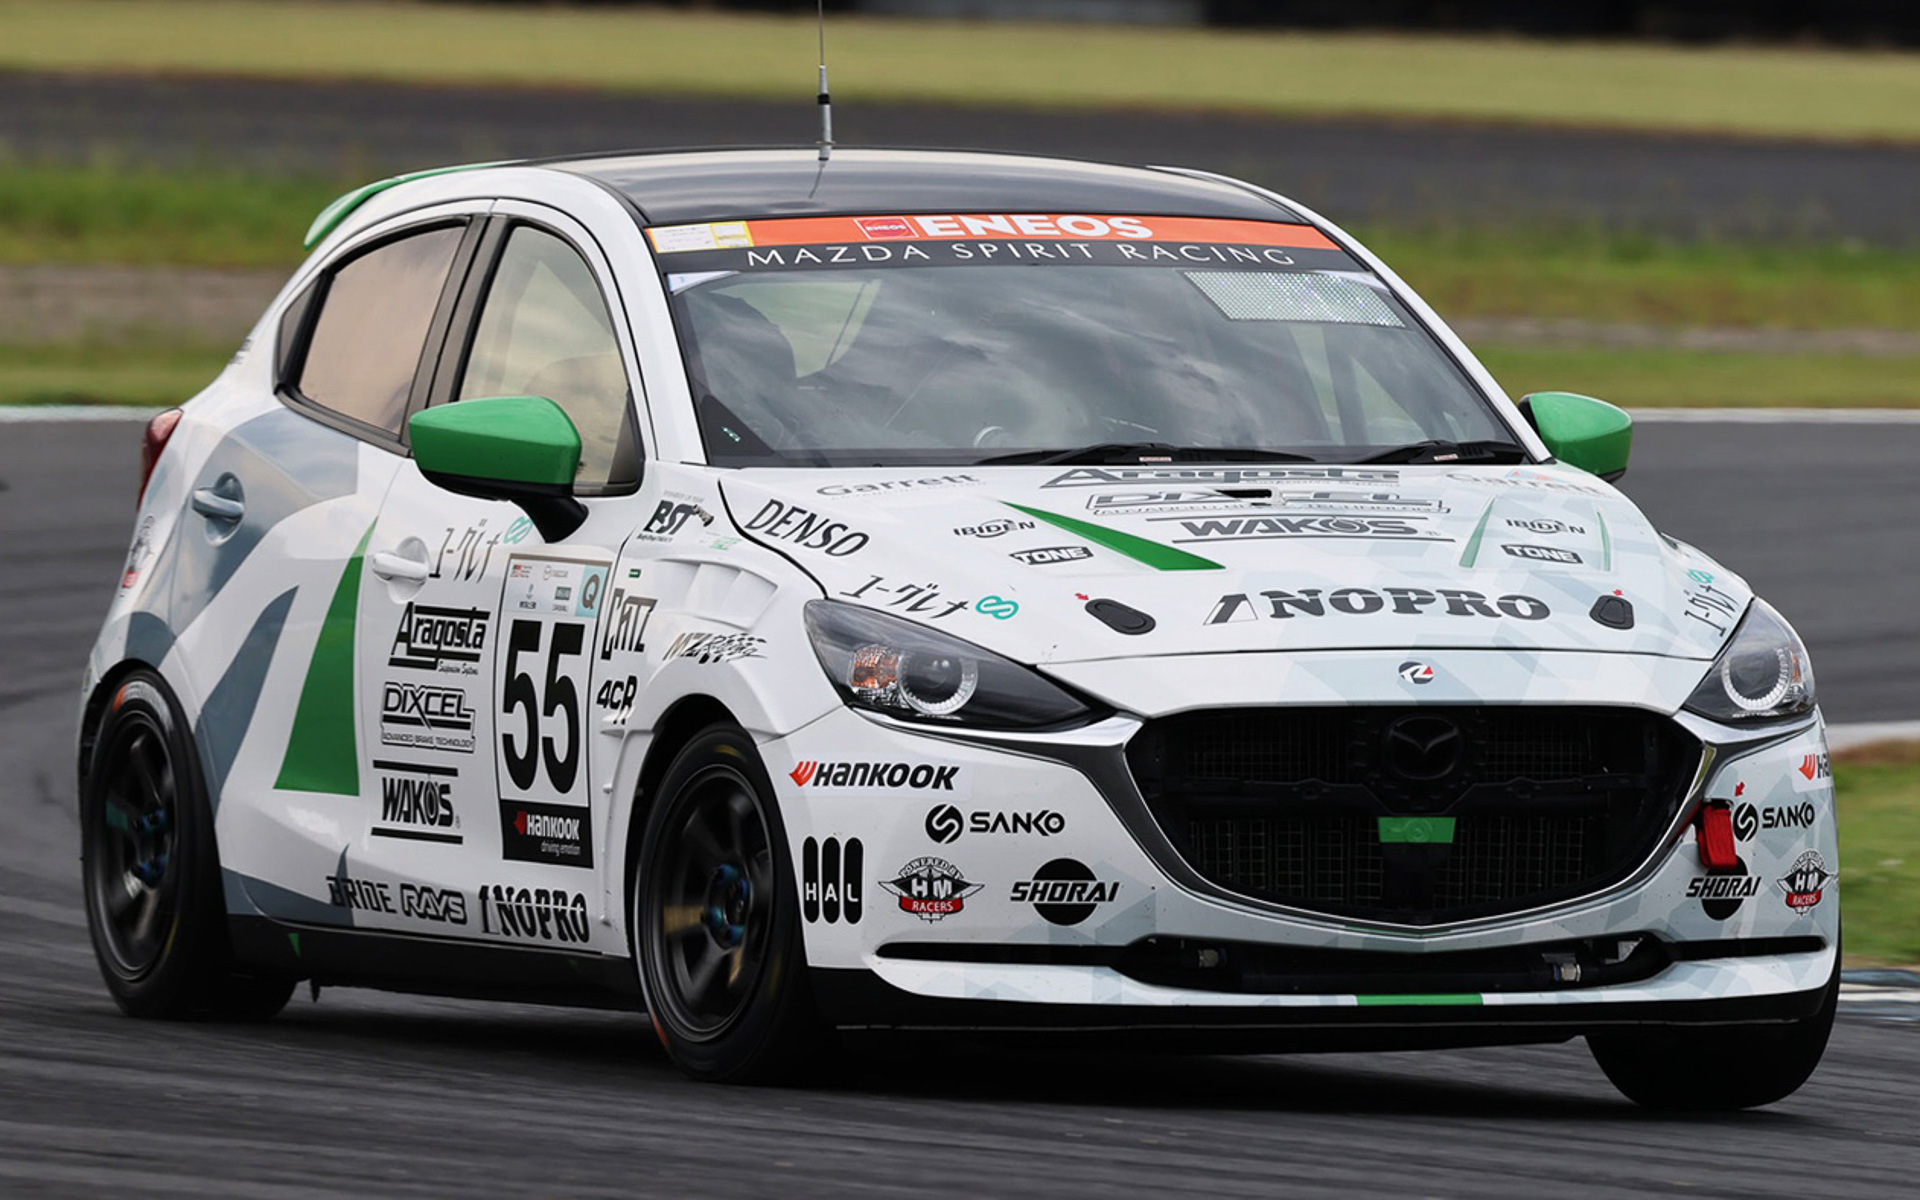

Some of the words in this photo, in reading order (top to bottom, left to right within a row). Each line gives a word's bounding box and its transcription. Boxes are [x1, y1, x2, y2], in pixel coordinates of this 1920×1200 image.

[913, 215, 1153, 239] ENEOS
[747, 245, 930, 267] MAZDA
[951, 243, 1093, 259] SPIRIT
[1117, 244, 1295, 266] RACING
[816, 474, 980, 496] Garrett
[1040, 467, 1400, 490] Aragosta
[744, 499, 870, 557] DENSO
[953, 519, 1036, 538] IBIDEN
[1505, 519, 1586, 534] IBIDEN
[1013, 548, 1089, 564] TONE
[1507, 547, 1575, 563] TONE
[582, 573, 600, 610] Q
[1259, 588, 1551, 620] NOPRO
[390, 602, 491, 664] Aragosta
[383, 688, 472, 731] DIXCEL
[502, 619, 585, 794] 55
[970, 810, 1065, 836] SANKO
[1762, 802, 1815, 829] SANKO
[326, 876, 397, 914] BRIDE
[911, 879, 953, 899] HM
[1010, 881, 1120, 902] SHORAI
[1686, 877, 1761, 897] SHORAI
[399, 883, 468, 925] RAYS
[493, 885, 590, 943] NOPRO
[911, 901, 954, 912] RACERS
